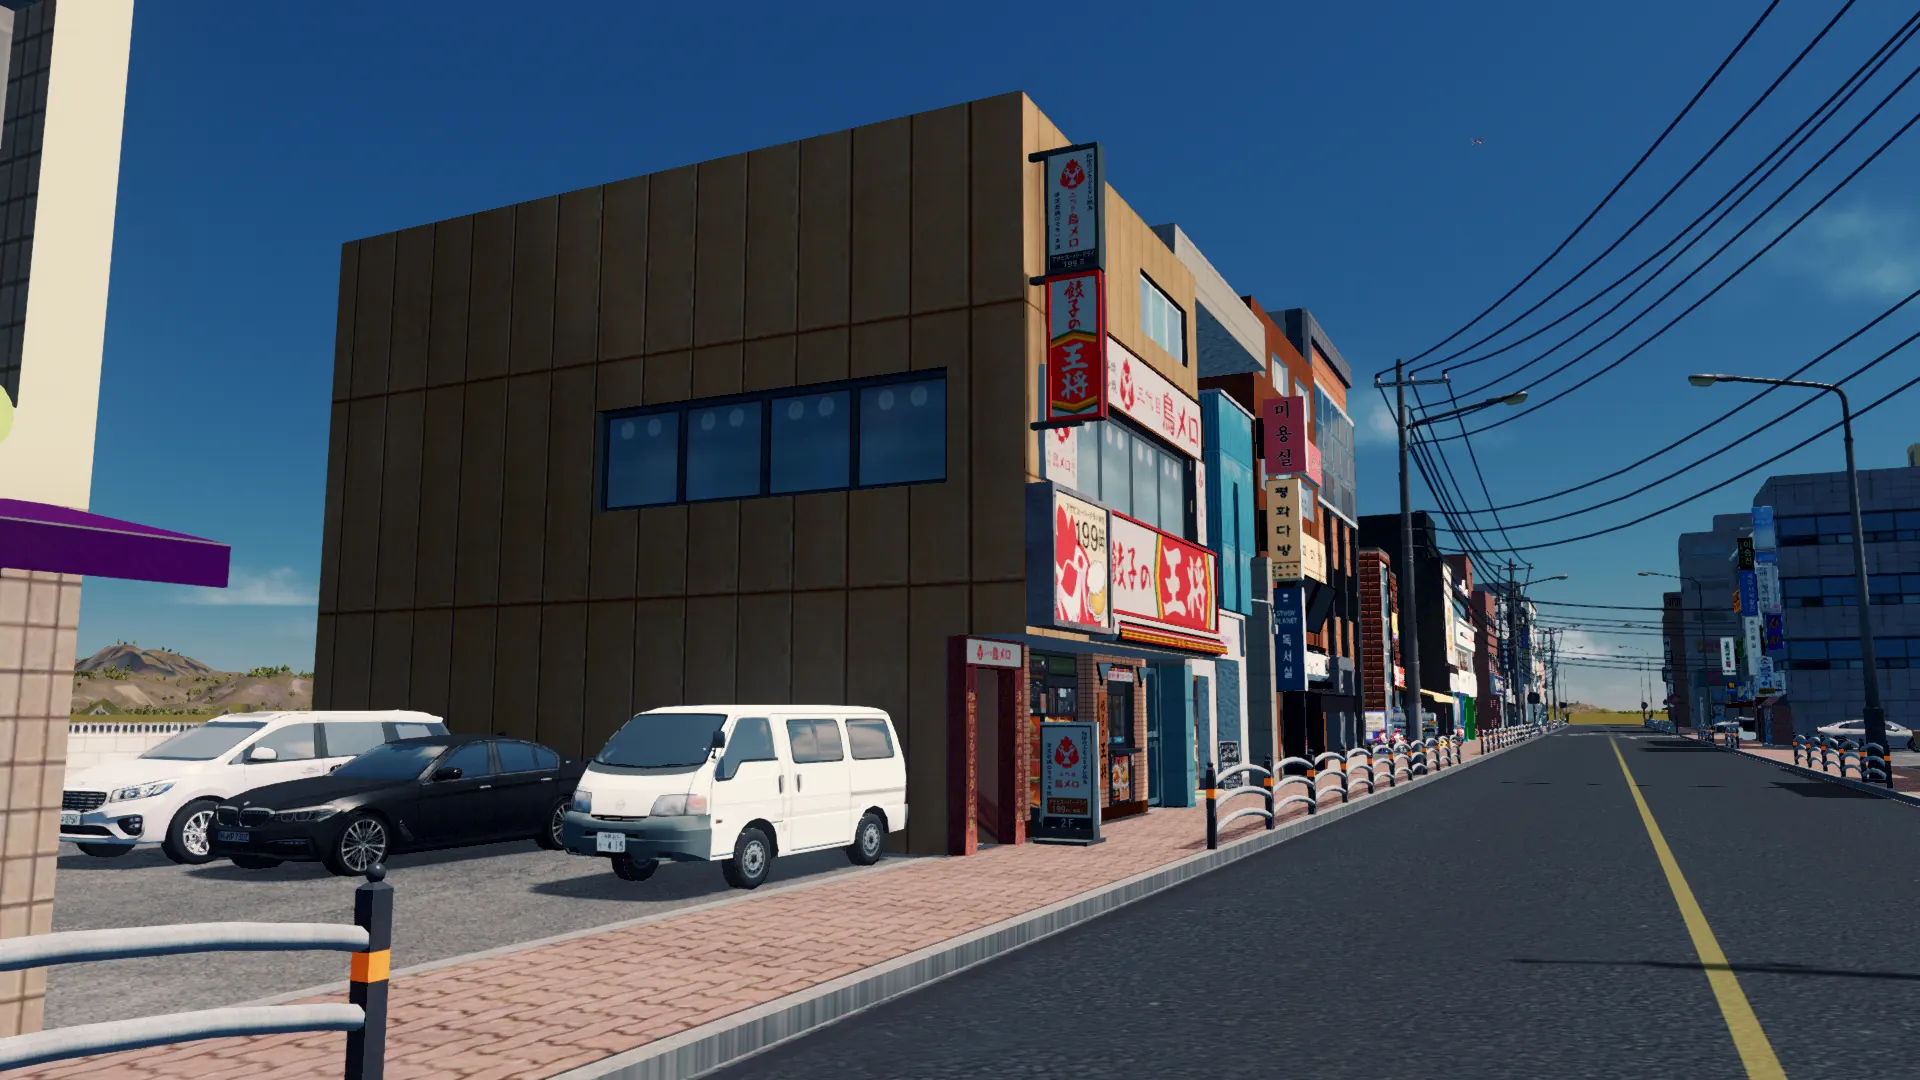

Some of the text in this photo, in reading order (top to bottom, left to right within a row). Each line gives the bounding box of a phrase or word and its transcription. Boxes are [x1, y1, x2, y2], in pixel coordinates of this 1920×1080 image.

[1275, 400, 1292, 467] 미용실
[1275, 486, 1291, 556] 평화다방
[1112, 540, 1206, 622] 餃子の王将
[1276, 617, 1298, 625] PLANET
[1282, 634, 1293, 679] 독서실
[1061, 818, 1074, 828] 2F
